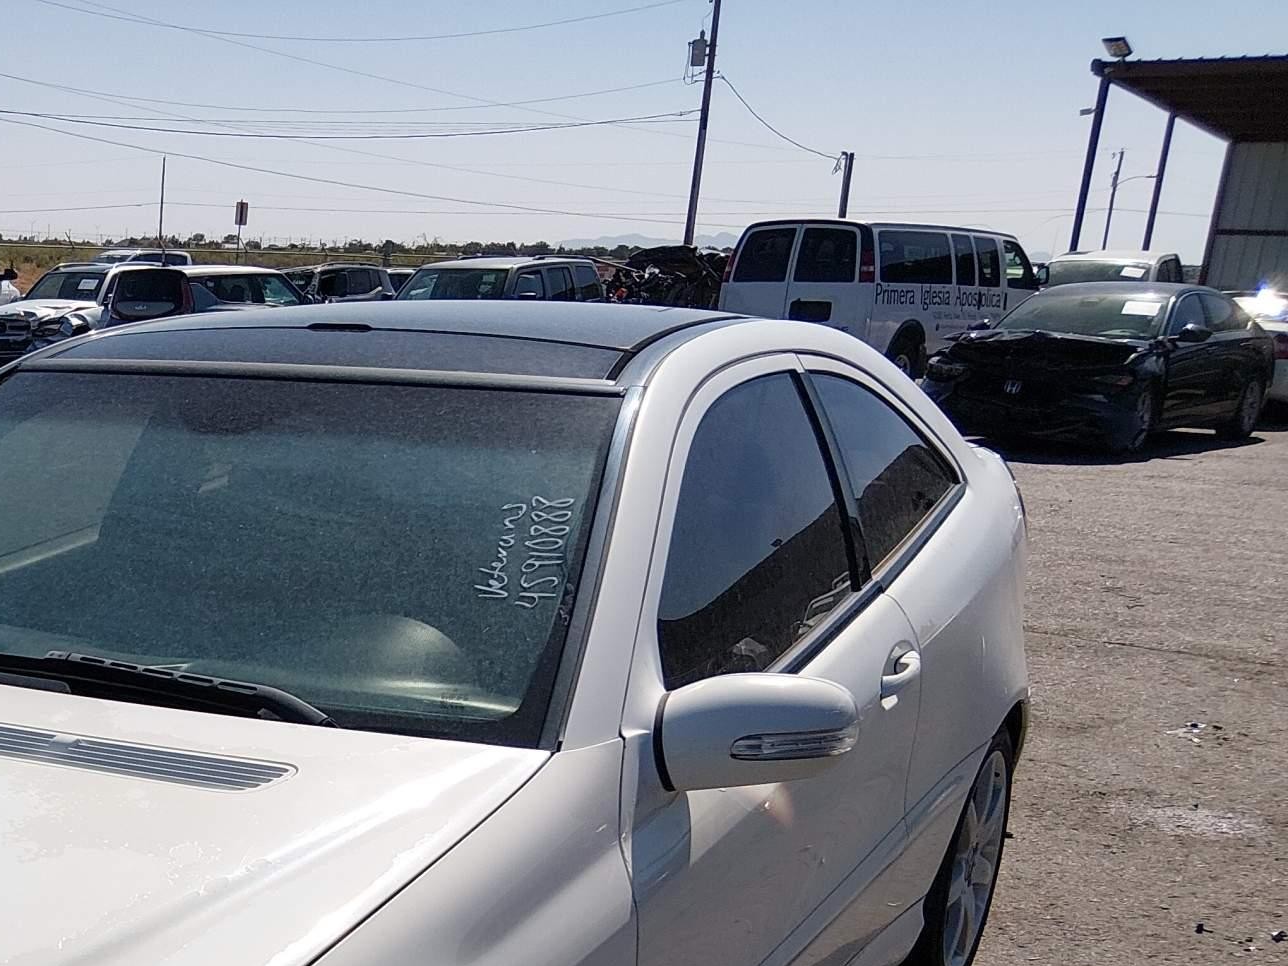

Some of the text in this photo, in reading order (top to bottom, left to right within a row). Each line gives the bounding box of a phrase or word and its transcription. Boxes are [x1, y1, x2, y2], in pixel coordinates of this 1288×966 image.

[875, 283, 1001, 312] Primera Iglesia Aposolica
[514, 495, 575, 608] 45910888
